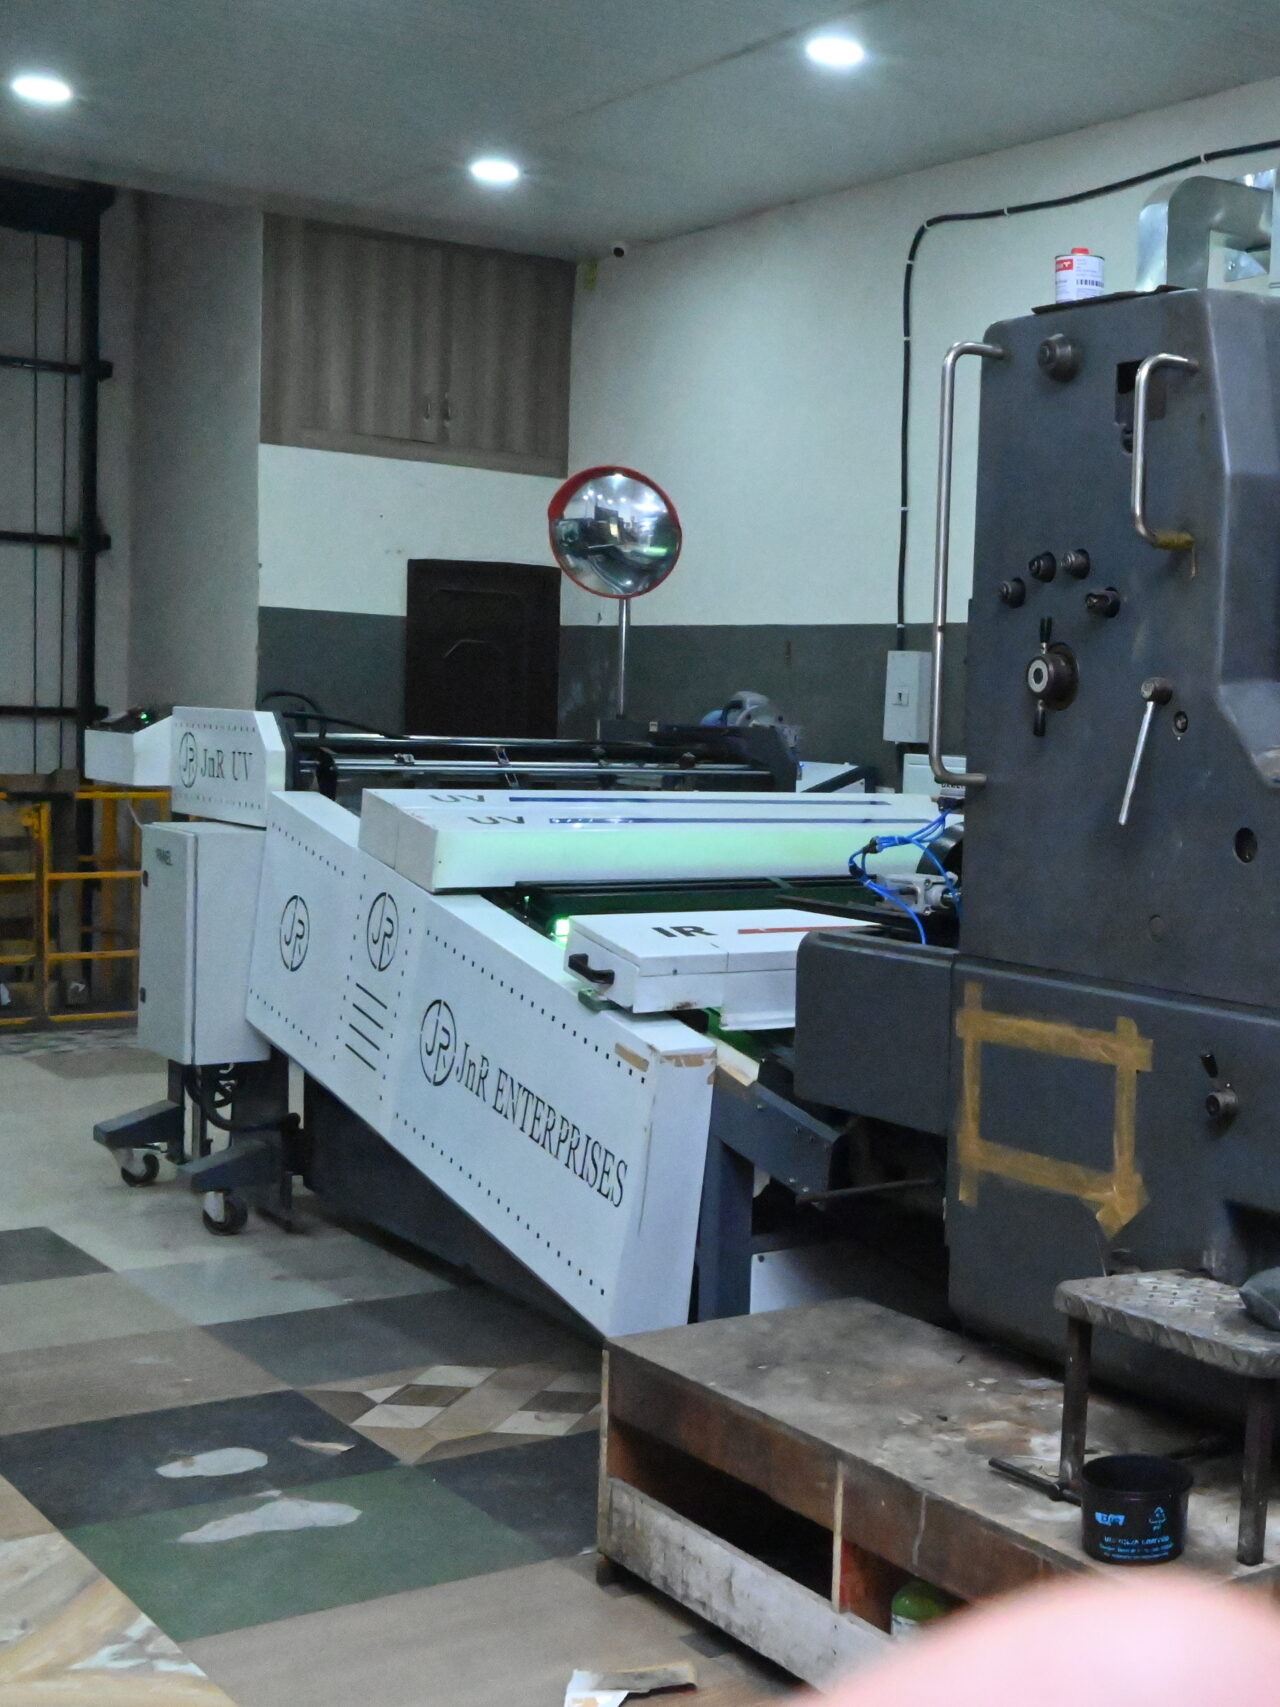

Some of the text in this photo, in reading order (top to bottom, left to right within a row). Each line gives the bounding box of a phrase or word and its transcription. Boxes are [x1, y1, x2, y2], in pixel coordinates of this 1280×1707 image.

[201, 748, 225, 780] JnR
[231, 751, 253, 782] UV
[429, 794, 486, 804] UV
[466, 815, 526, 826] UV
[651, 925, 719, 938] IR
[456, 1042, 629, 1208] JnR ENTERPRISES
